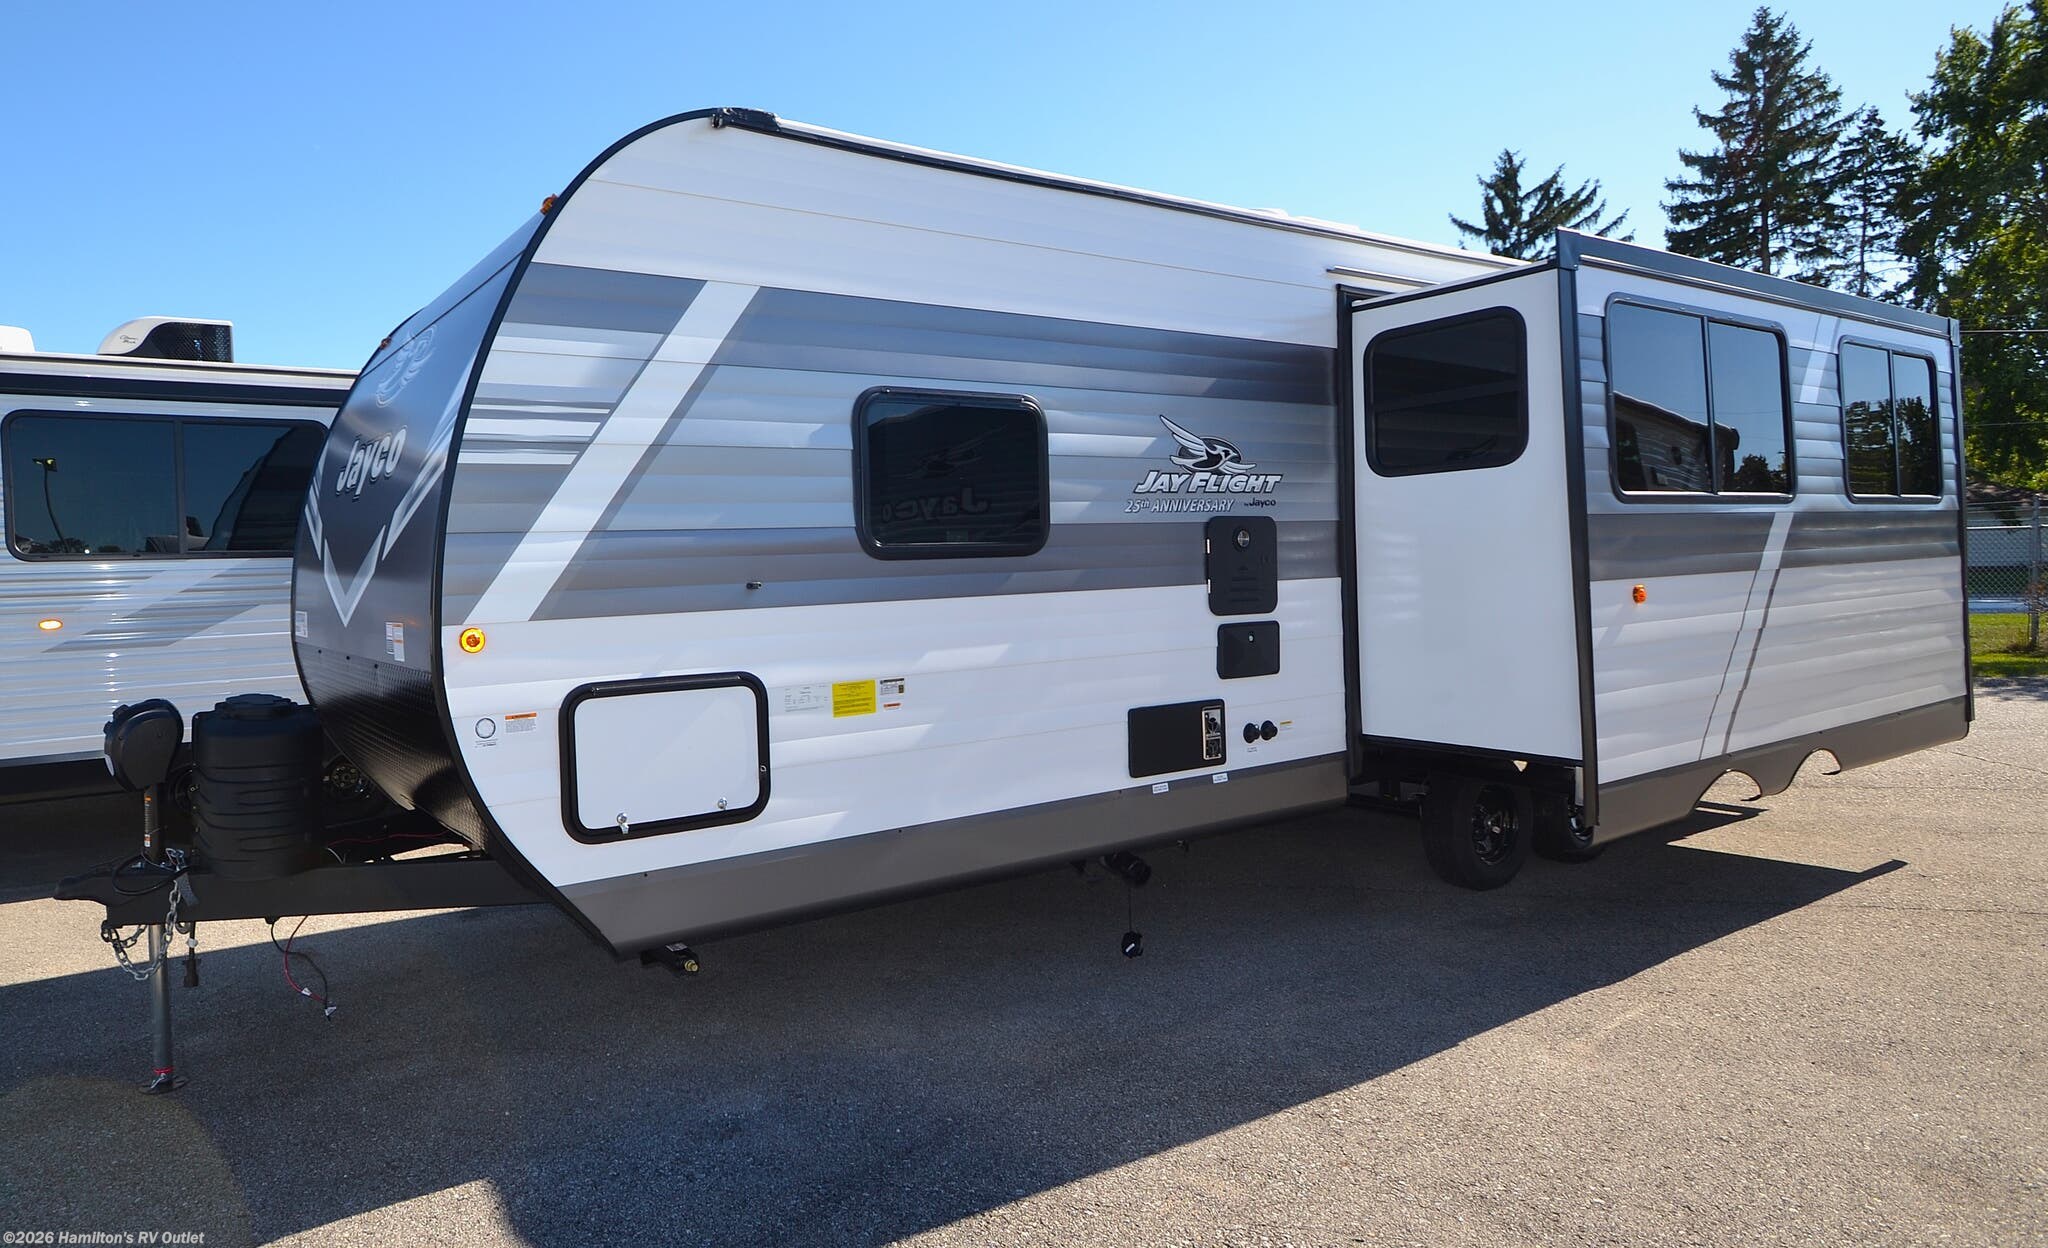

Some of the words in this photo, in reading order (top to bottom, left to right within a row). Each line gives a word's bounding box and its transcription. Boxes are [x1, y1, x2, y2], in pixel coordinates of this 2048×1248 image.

[335, 427, 408, 501] Jayco
[1134, 470, 1190, 494] JAY
[1187, 472, 1283, 494] FLIGHT
[1124, 499, 1150, 513] 25th
[1151, 498, 1234, 513] ANNIVERSARY
[1249, 497, 1277, 508] Jayco
